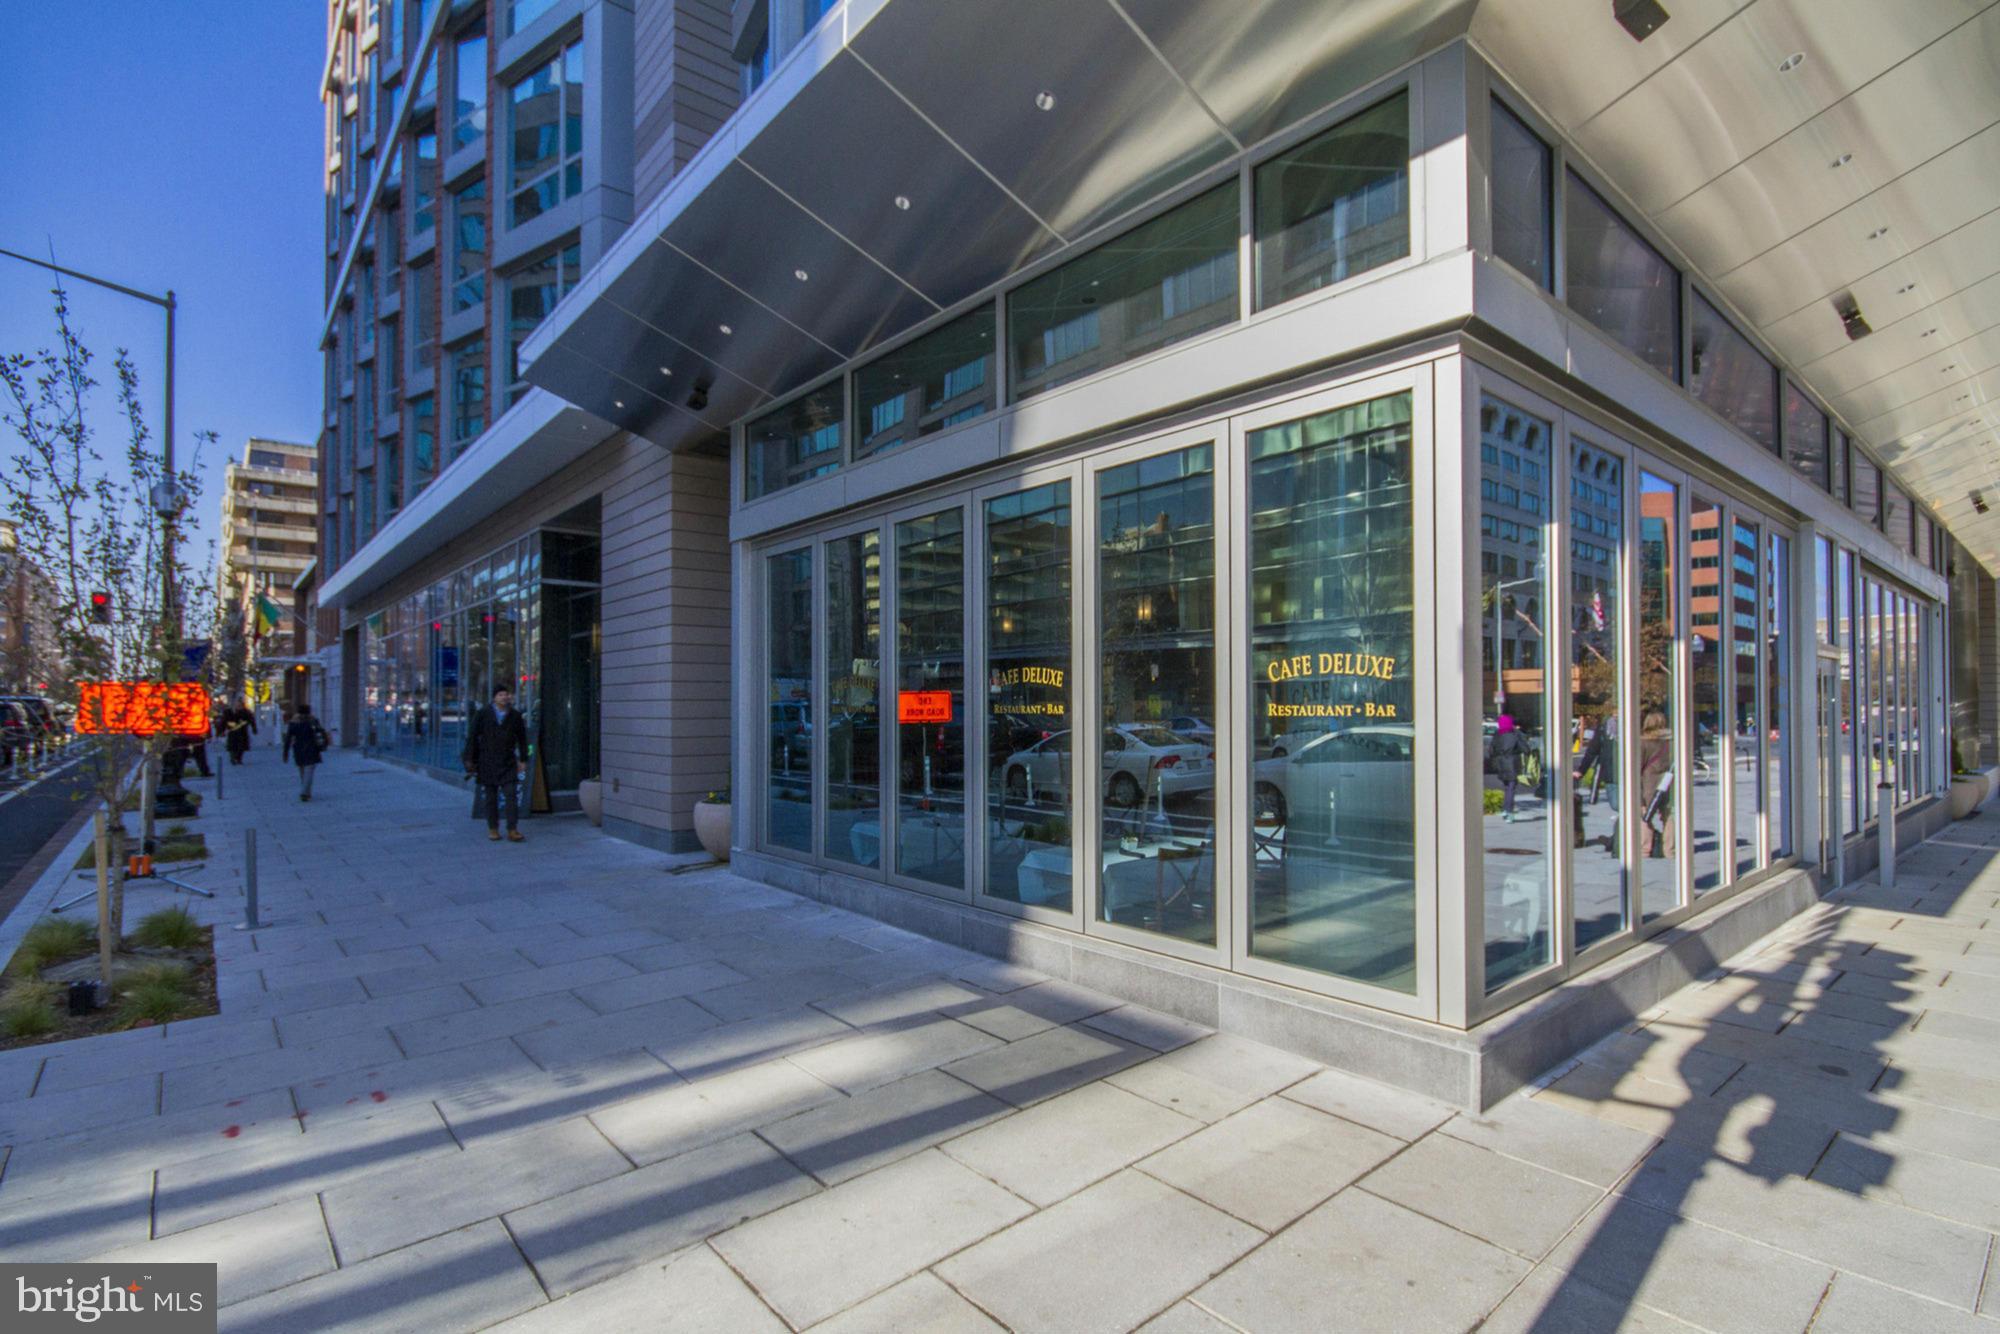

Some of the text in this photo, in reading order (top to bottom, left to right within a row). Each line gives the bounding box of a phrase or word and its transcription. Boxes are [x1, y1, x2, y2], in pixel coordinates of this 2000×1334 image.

[1022, 667, 1064, 688] DELUXE
[1267, 653, 1396, 682] CAFE DELUXE
